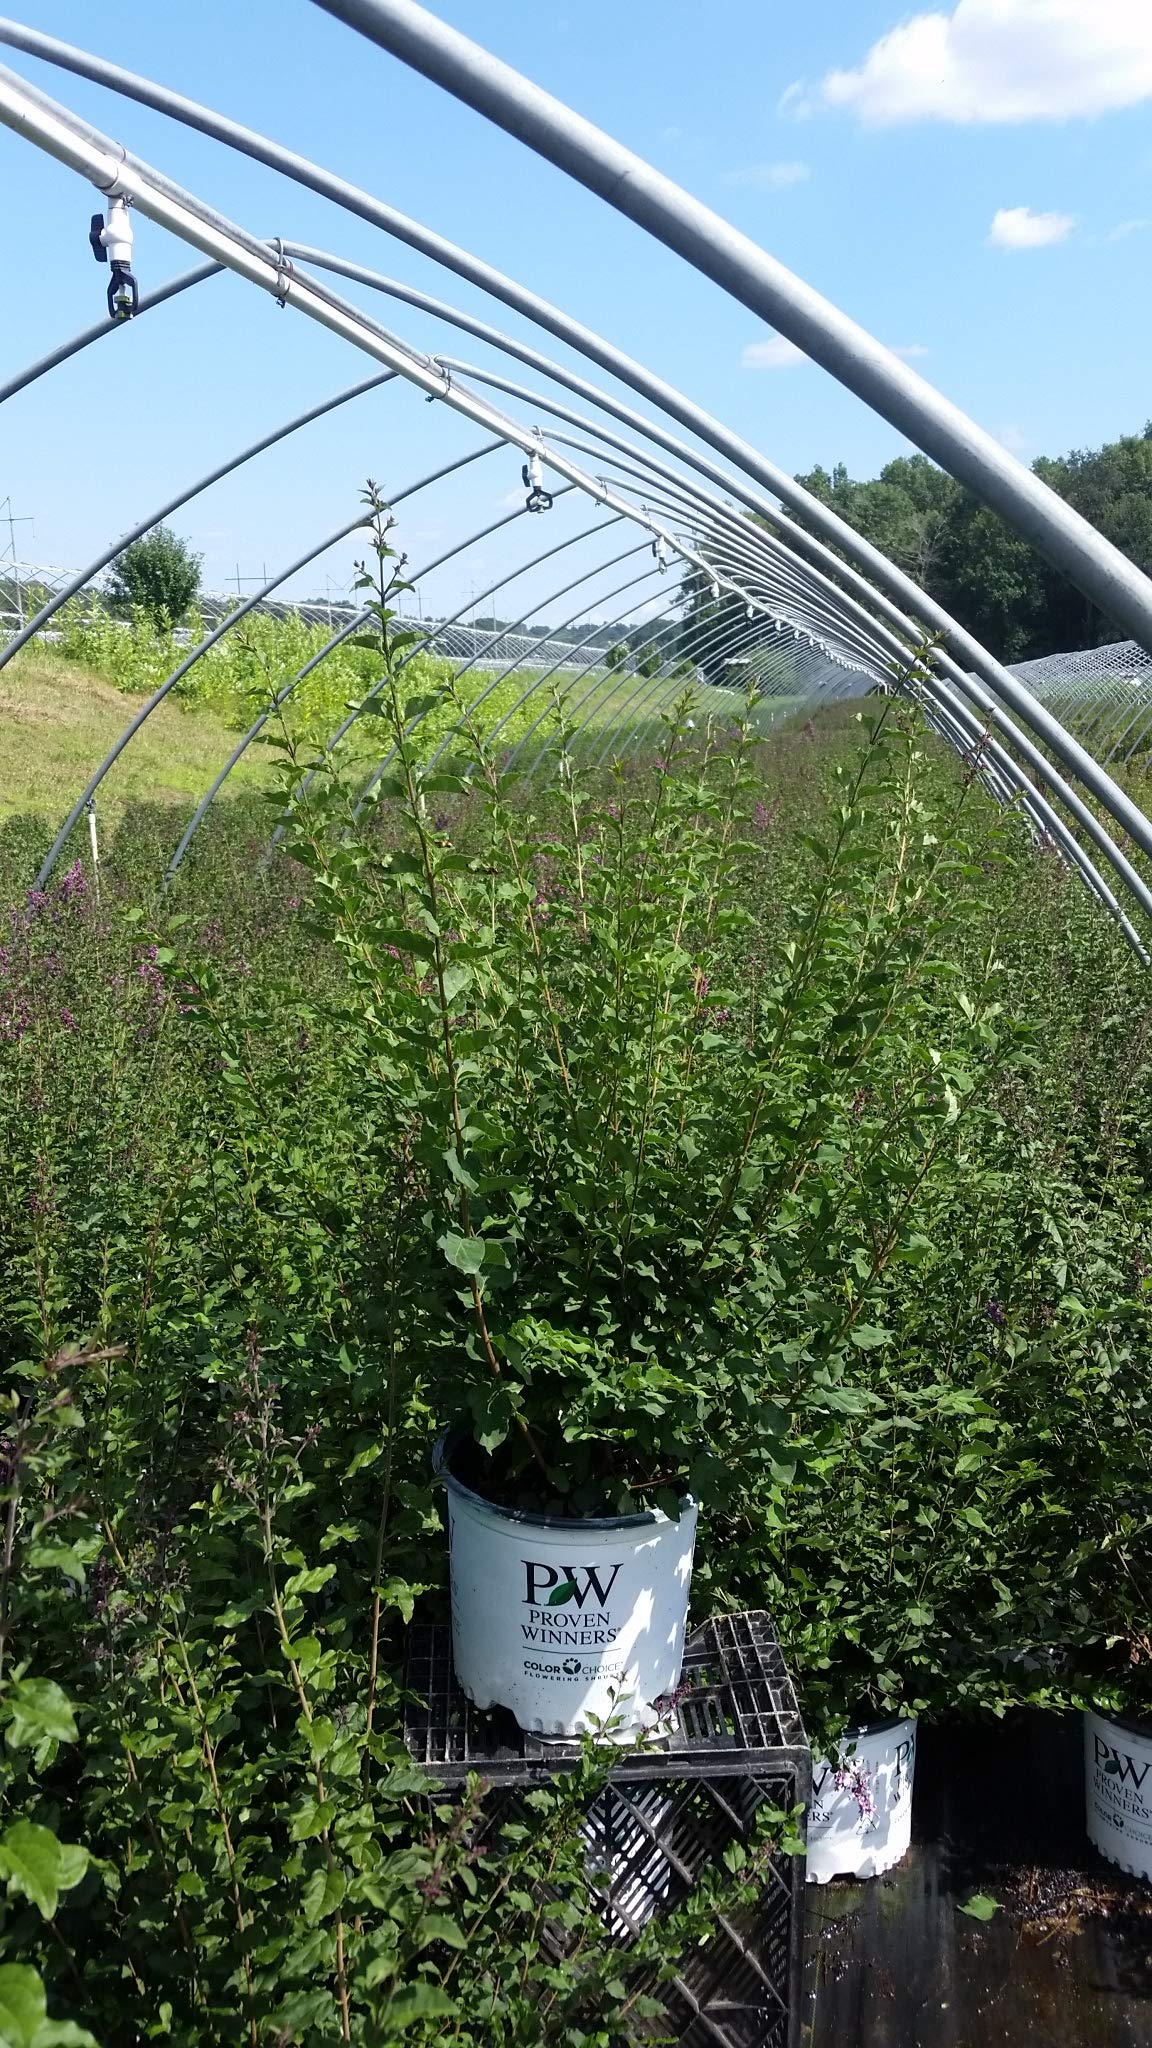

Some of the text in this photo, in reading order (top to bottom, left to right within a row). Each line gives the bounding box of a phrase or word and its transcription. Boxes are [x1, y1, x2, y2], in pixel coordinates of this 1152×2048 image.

[520, 1559, 624, 1609] PW
[528, 1609, 611, 1628] PROVEN
[523, 1660, 620, 1675] COLOR CHOICE
[524, 1670, 579, 1682] FLOWERING
[1096, 1767, 1144, 1805] PROVEN
